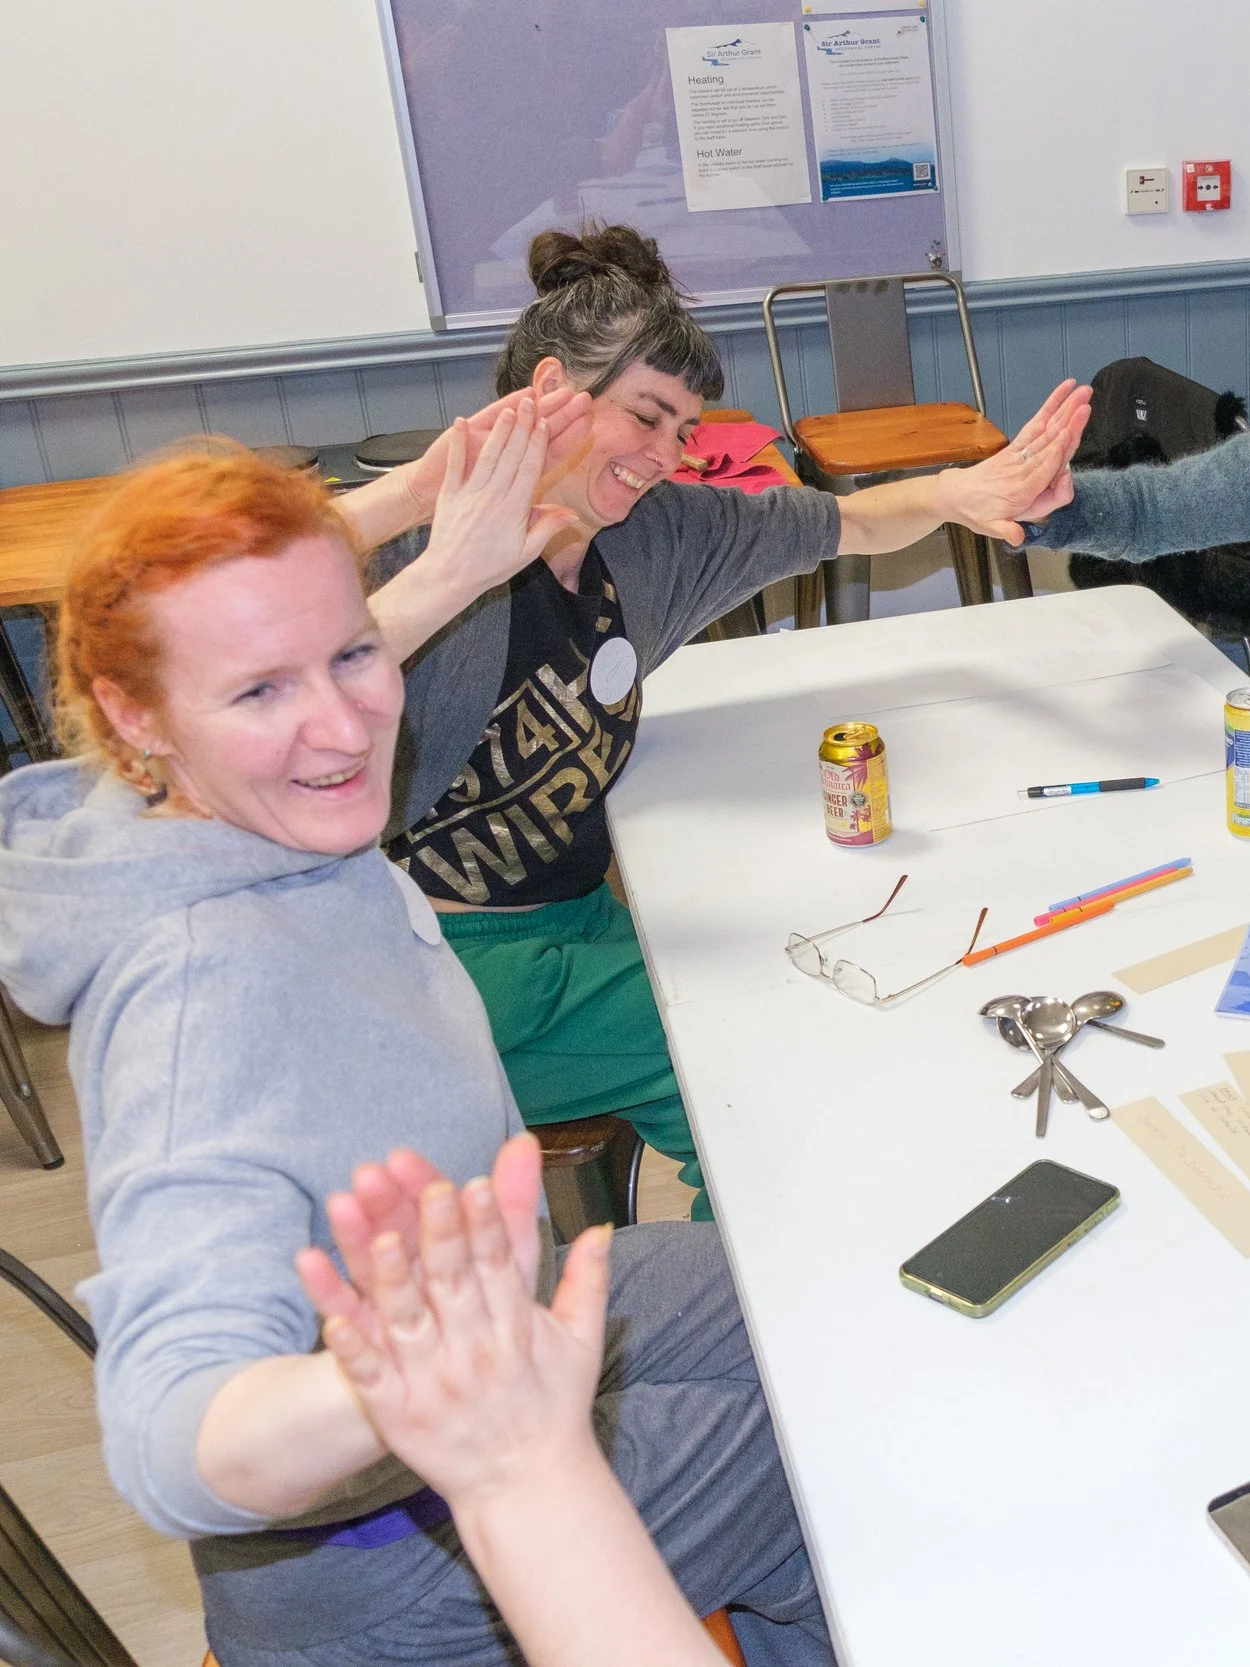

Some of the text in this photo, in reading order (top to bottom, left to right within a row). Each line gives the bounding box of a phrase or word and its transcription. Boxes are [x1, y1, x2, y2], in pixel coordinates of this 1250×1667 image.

[706, 48, 761, 58] Sir Arthur Grant
[688, 75, 724, 86] Heating
[696, 147, 742, 159] Hot Water
[425, 699, 560, 821] 974
[416, 715, 631, 906] WIRE
